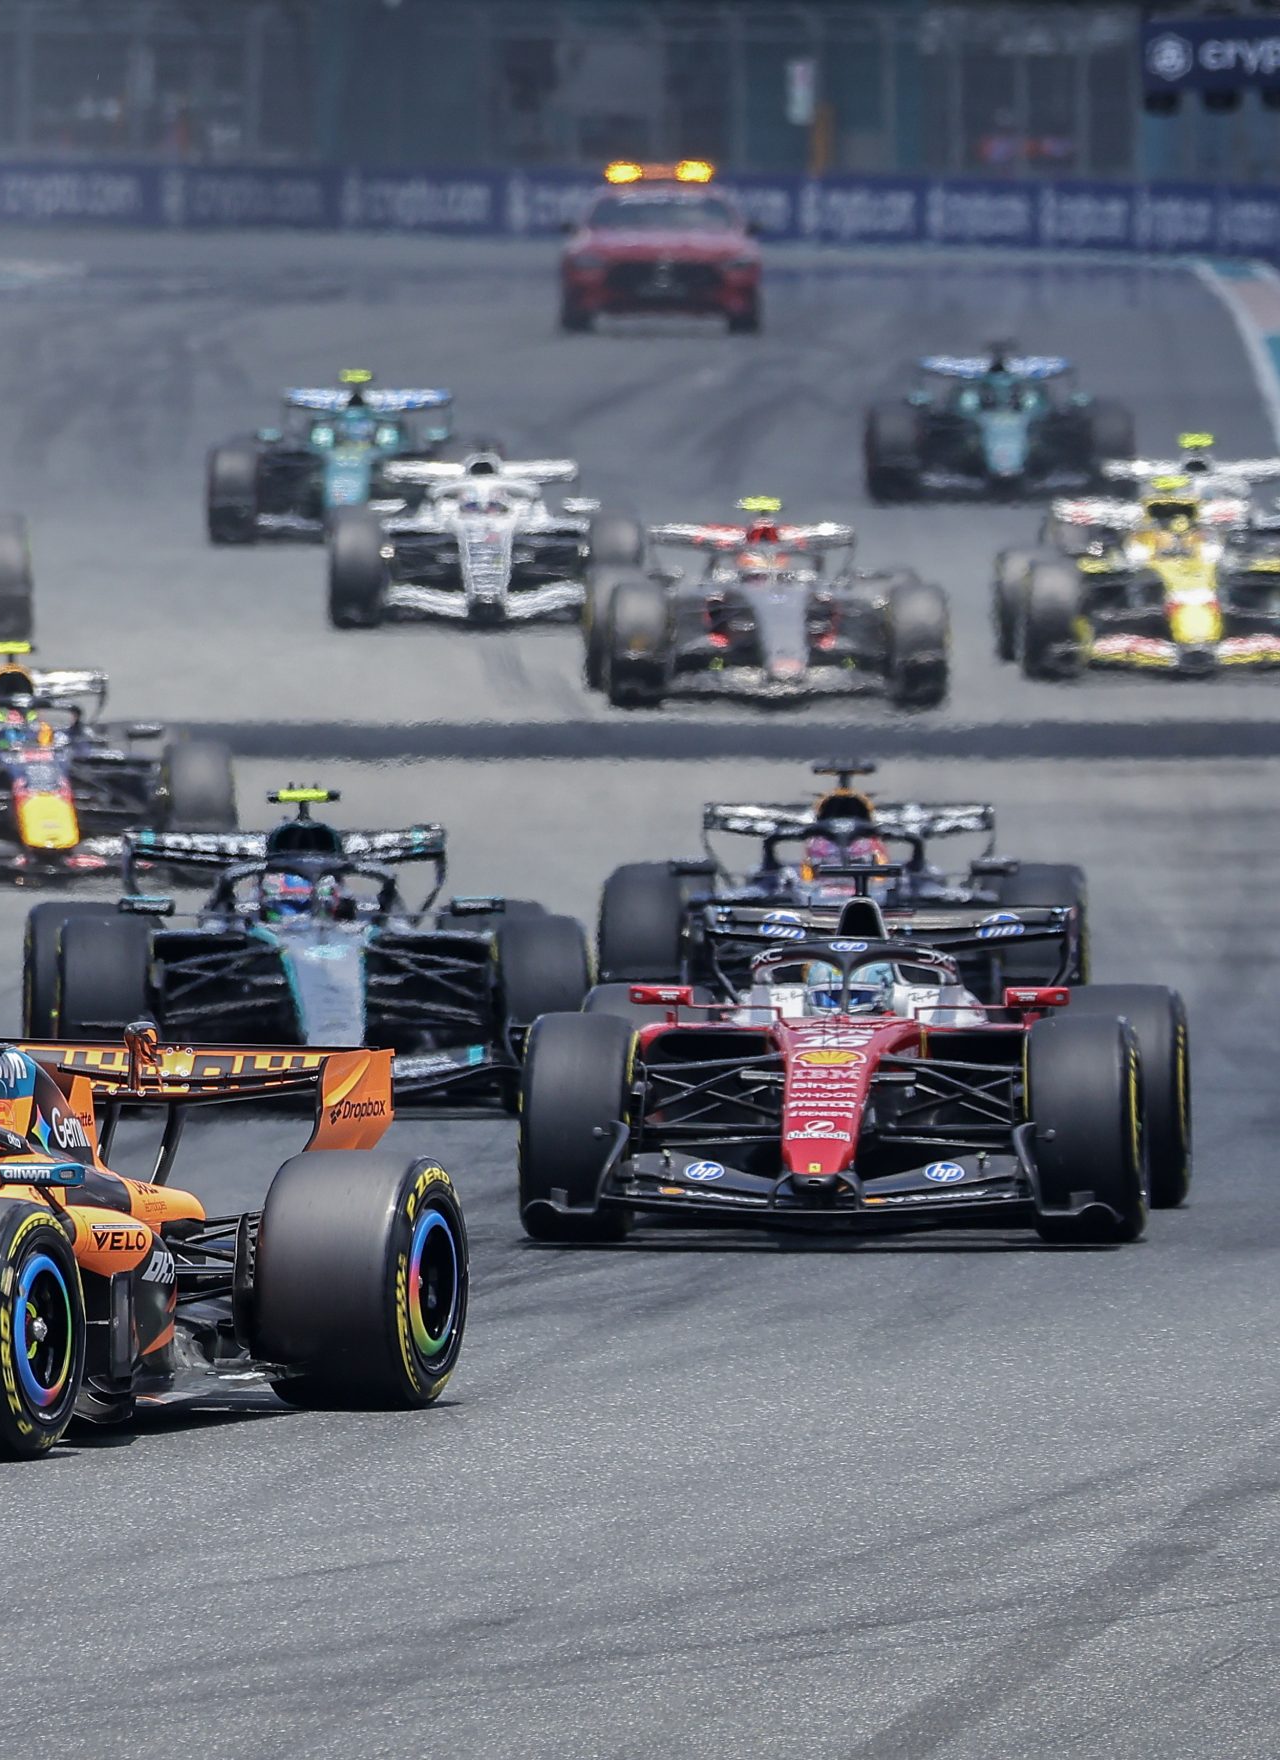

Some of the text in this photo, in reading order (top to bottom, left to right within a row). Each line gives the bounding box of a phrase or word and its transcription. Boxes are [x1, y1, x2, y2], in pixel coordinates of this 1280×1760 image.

[792, 1069, 861, 1080] IBM
[342, 1099, 386, 1119] Dropbox
[3, 1168, 51, 1182] allwyn
[688, 1162, 722, 1180] hp
[930, 1162, 961, 1181] hp
[93, 1231, 147, 1251] VELO
